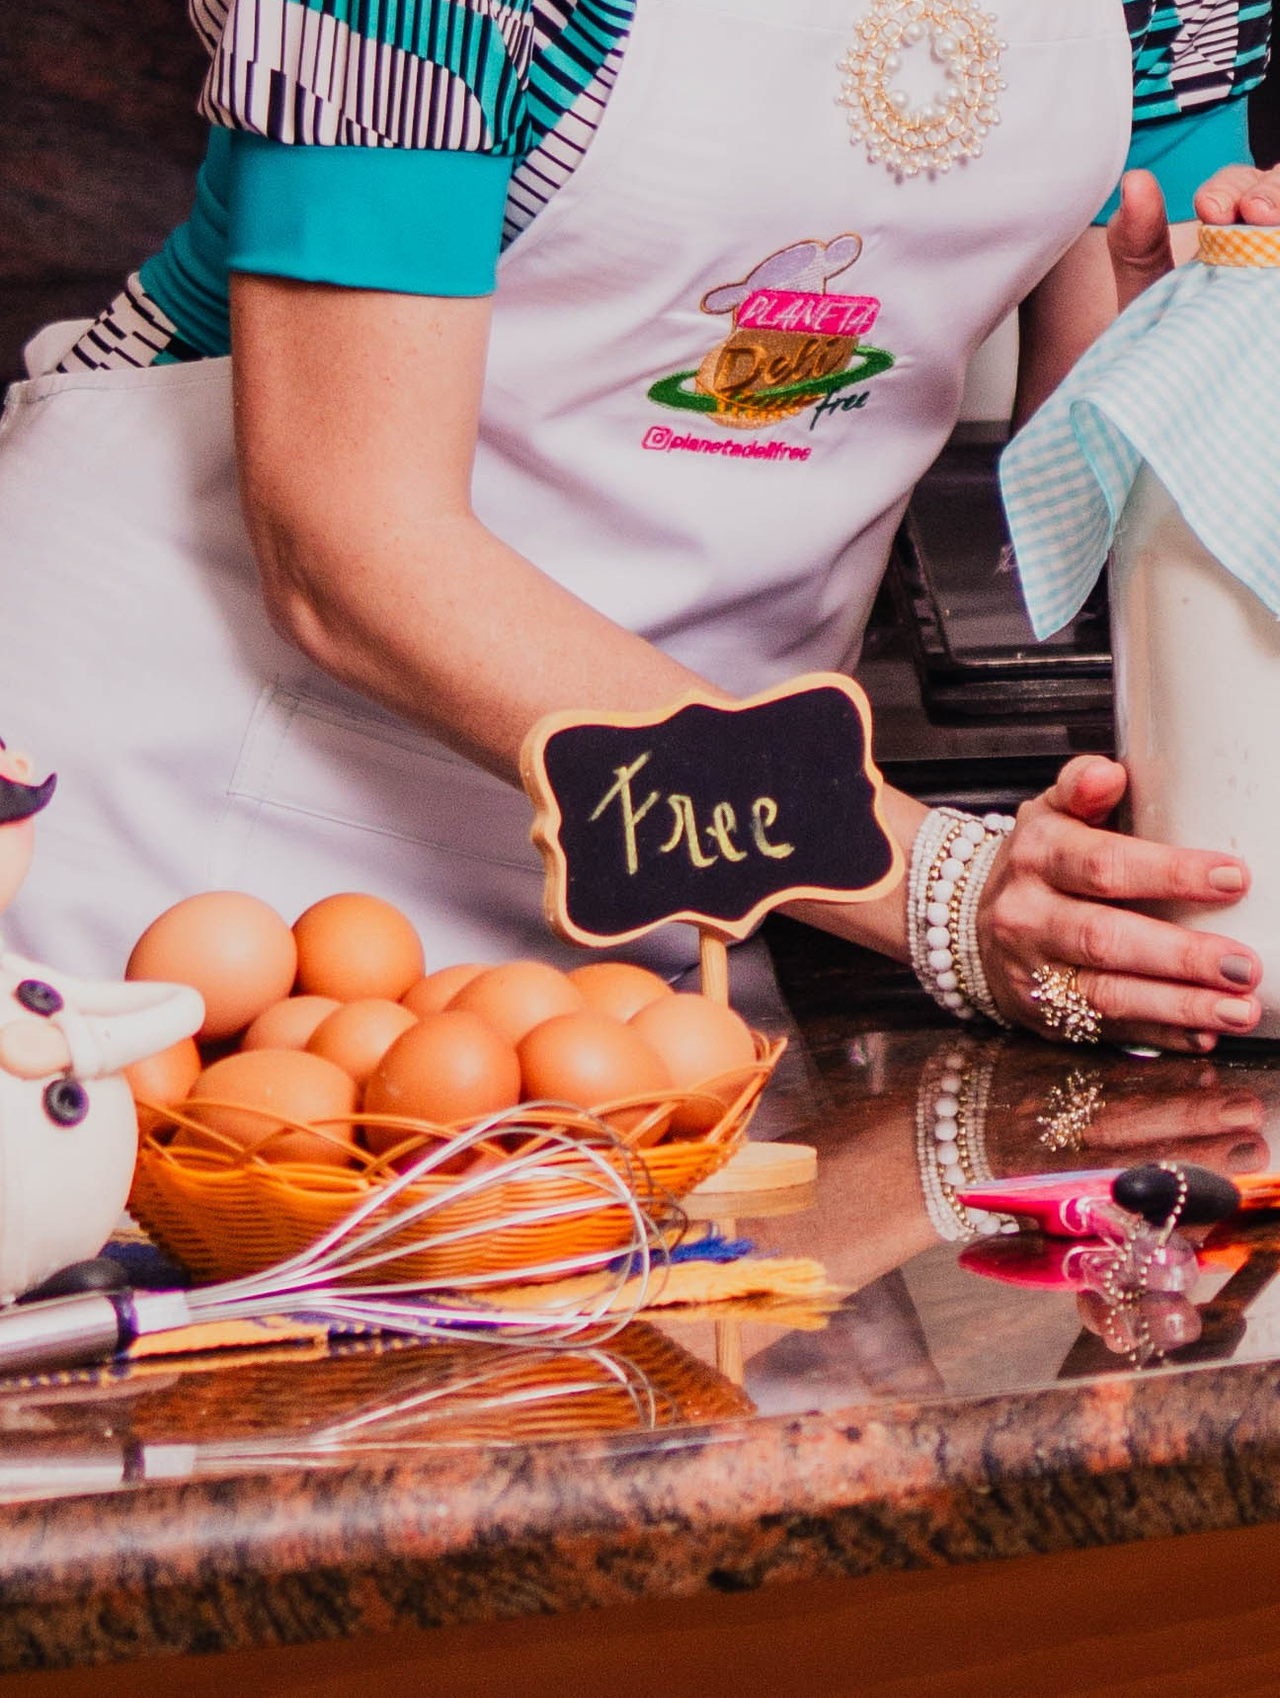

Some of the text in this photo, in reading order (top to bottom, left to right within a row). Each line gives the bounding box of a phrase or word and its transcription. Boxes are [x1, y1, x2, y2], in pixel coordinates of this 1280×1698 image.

[739, 295, 878, 333] PLANETA
[713, 337, 844, 393] Deli
[809, 386, 870, 431] free
[588, 750, 795, 876] Free
